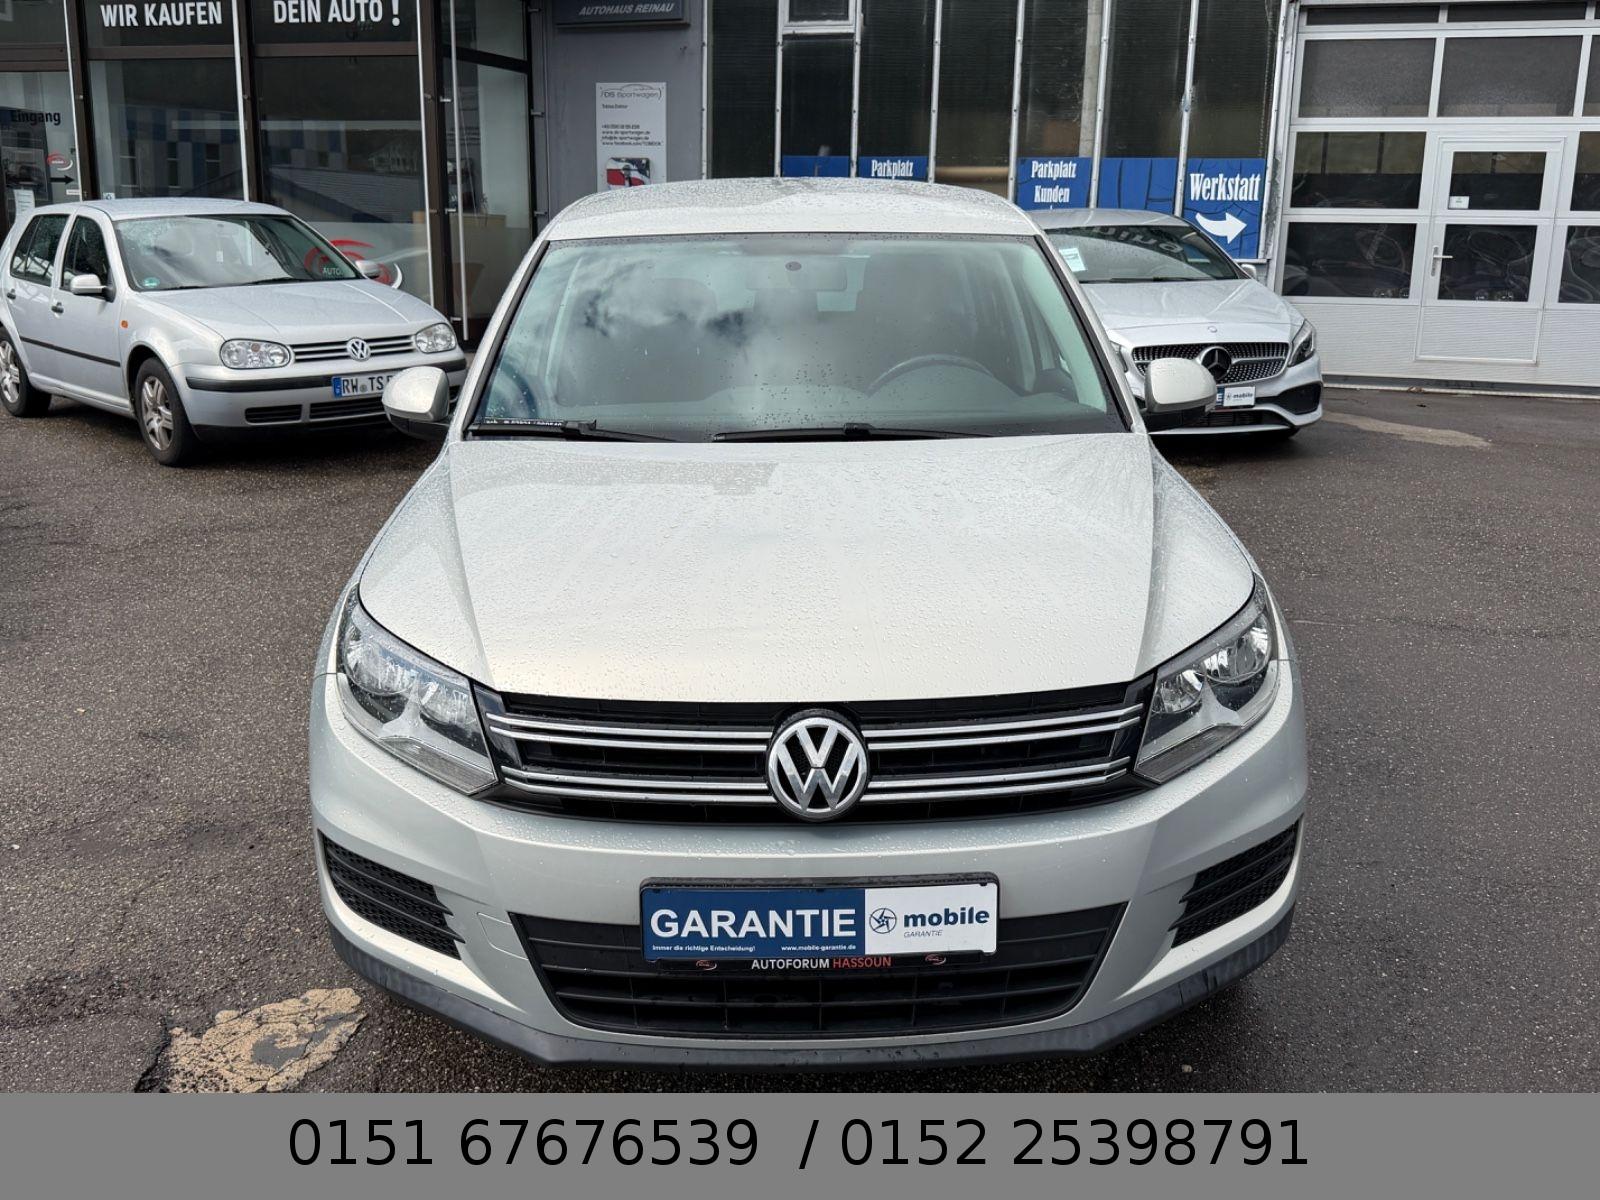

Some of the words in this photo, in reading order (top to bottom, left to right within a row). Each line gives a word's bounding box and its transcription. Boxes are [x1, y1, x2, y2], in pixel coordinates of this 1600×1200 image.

[100, 4, 139, 27] WIR
[144, 1, 222, 26] KAUFEN
[273, 0, 321, 23] DEIN
[327, 0, 383, 23] AUTO
[579, 4, 633, 16] AUTOHAUS
[634, 3, 674, 13] REINAU
[11, 111, 62, 126] Eingang
[870, 159, 914, 180] Parkplatz
[1030, 160, 1077, 179] Parkplatz
[1034, 185, 1070, 204] Kunden
[1189, 172, 1262, 202] Werkstatt
[342, 378, 359, 394] RW
[770, 719, 866, 817] VW
[650, 909, 857, 938] GARANTIE
[903, 906, 990, 928] mobile
[903, 929, 944, 939] GARANTIE
[652, 944, 673, 952] Immer
[684, 944, 709, 953] richtige
[709, 944, 756, 953] Entscheidung!
[781, 944, 857, 952] www.mobile-garantie.de
[751, 958, 830, 970] AUTOFORUM
[832, 956, 892, 969] HASSOUN
